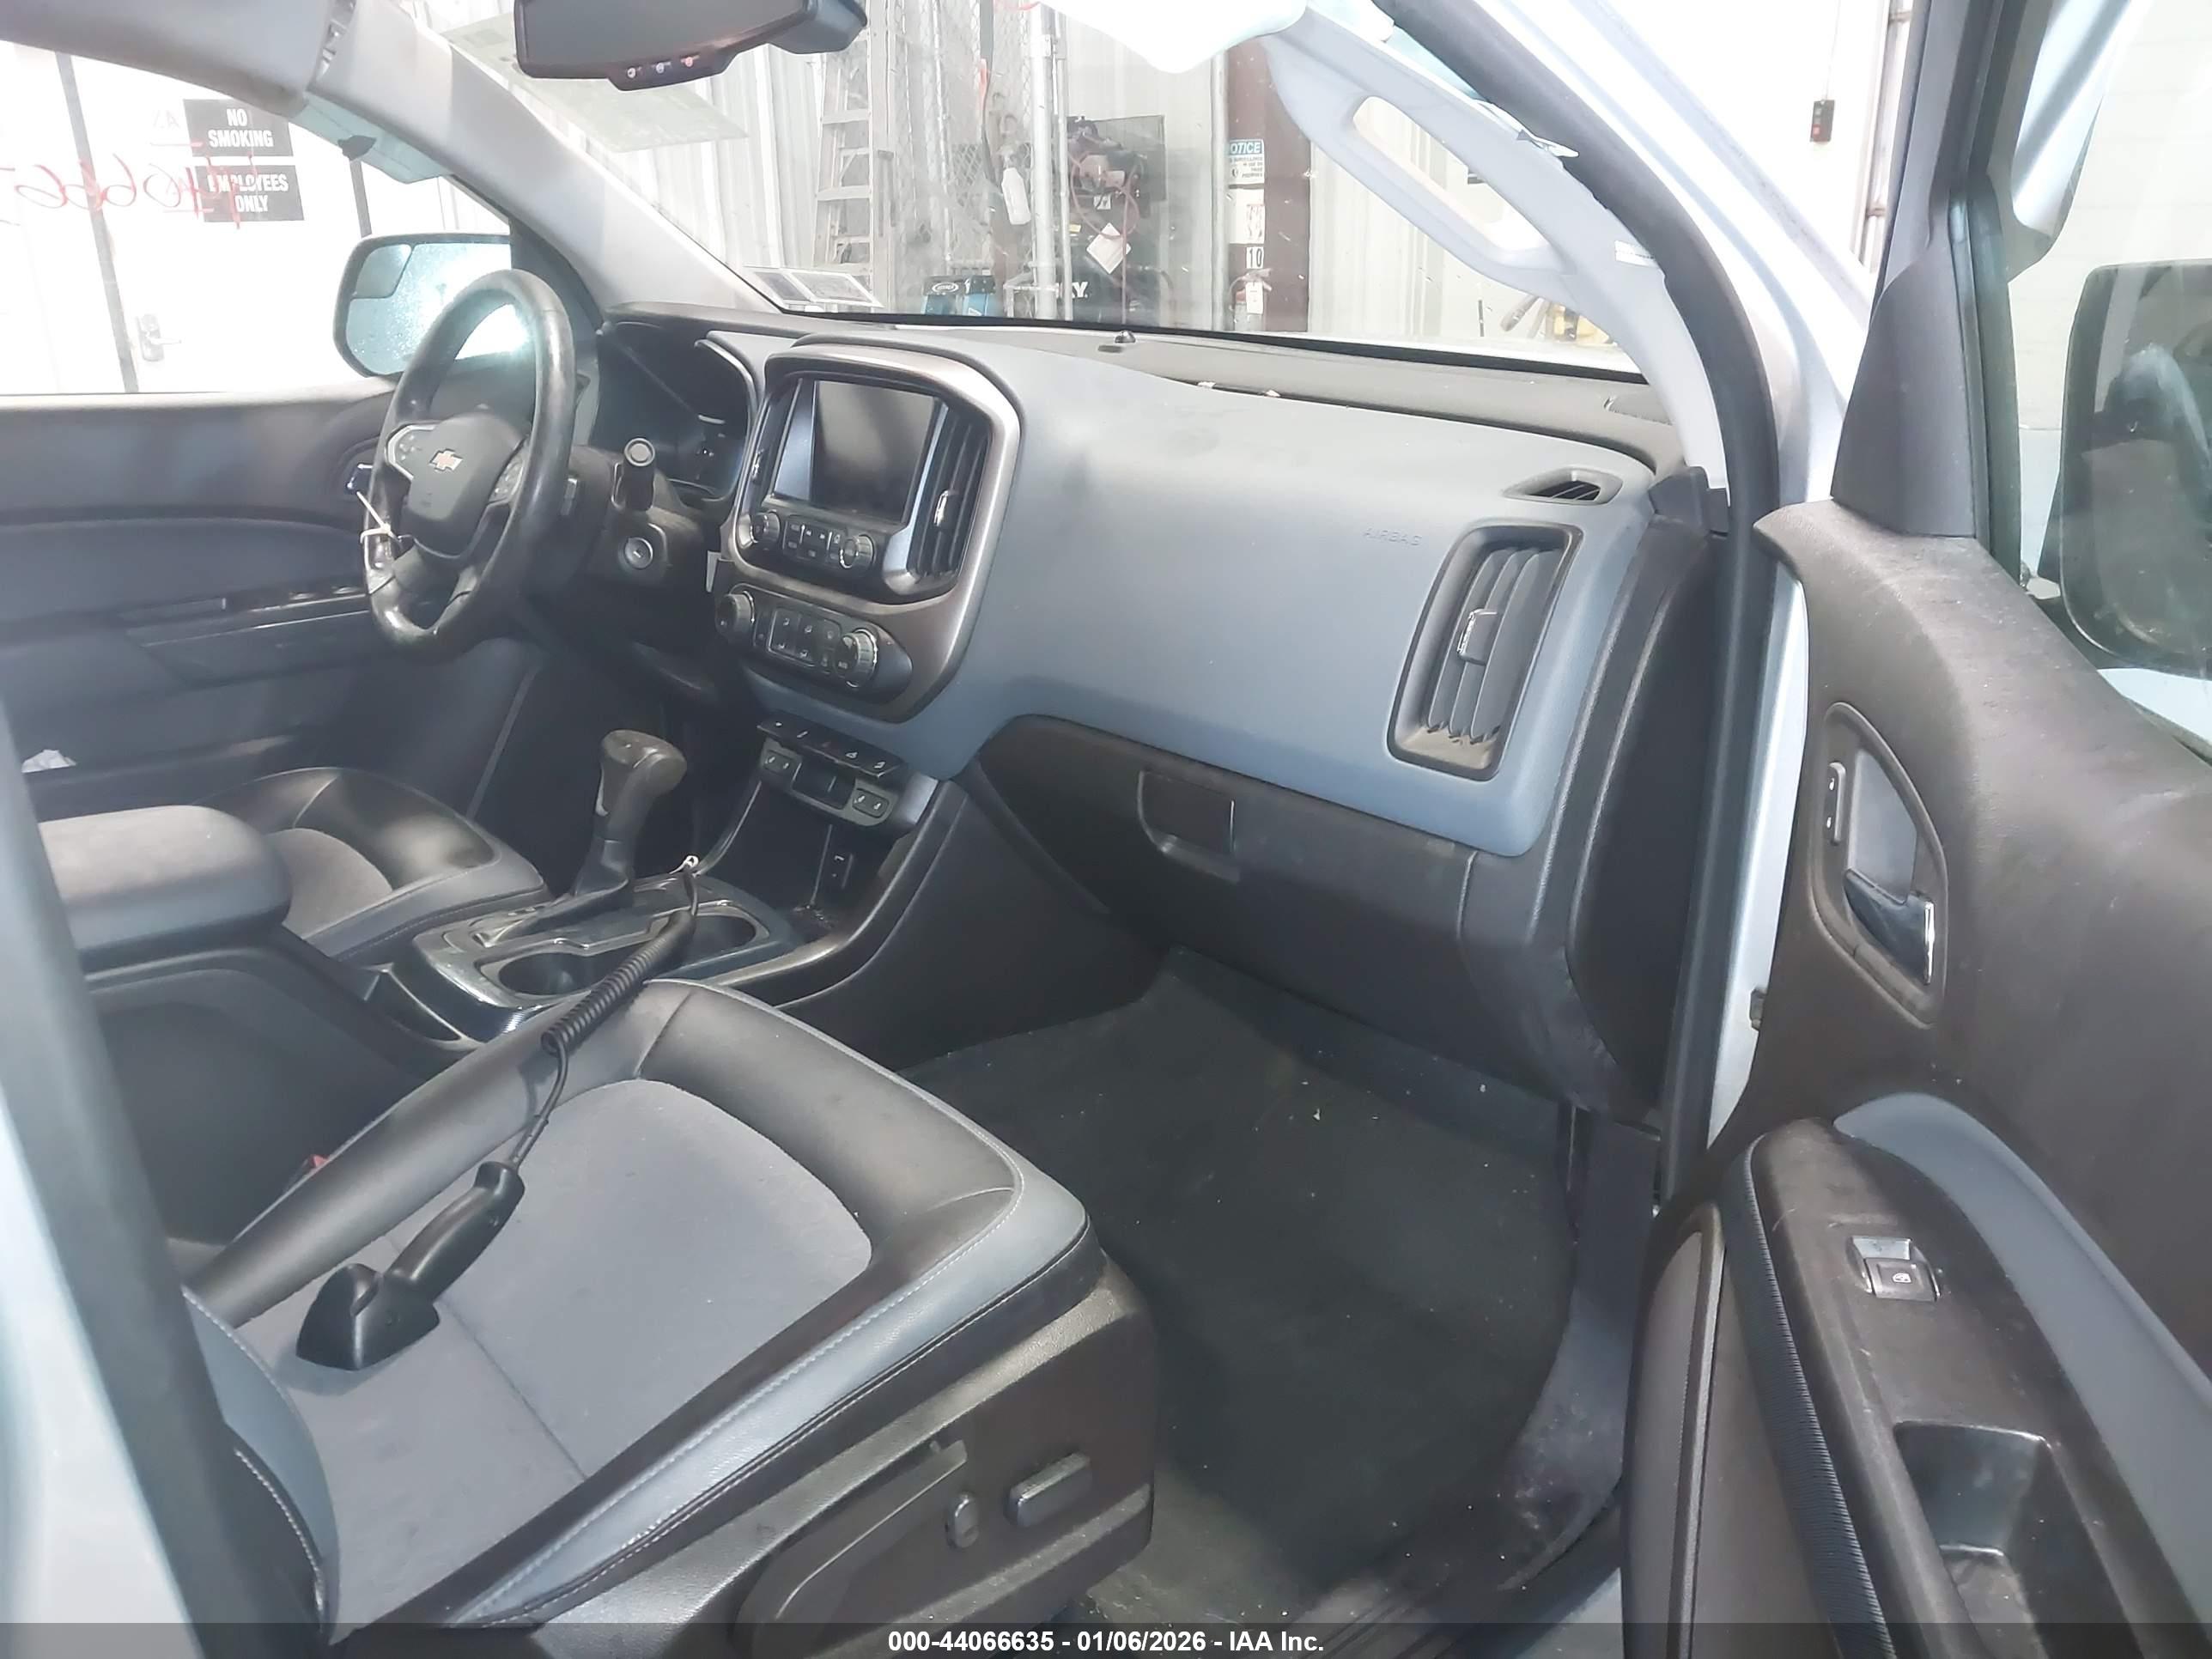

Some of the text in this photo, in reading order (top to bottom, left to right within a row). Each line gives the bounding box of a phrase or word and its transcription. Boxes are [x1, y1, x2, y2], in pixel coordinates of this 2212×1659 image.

[226, 108, 248, 126] NO
[208, 129, 274, 148] SMOKING
[1230, 142, 1261, 155] OTICE
[207, 174, 289, 192] EMPLOYEES
[234, 194, 269, 213] ONLY
[1249, 248, 1262, 268] 10
[1361, 526, 1423, 547] AIRBAG
